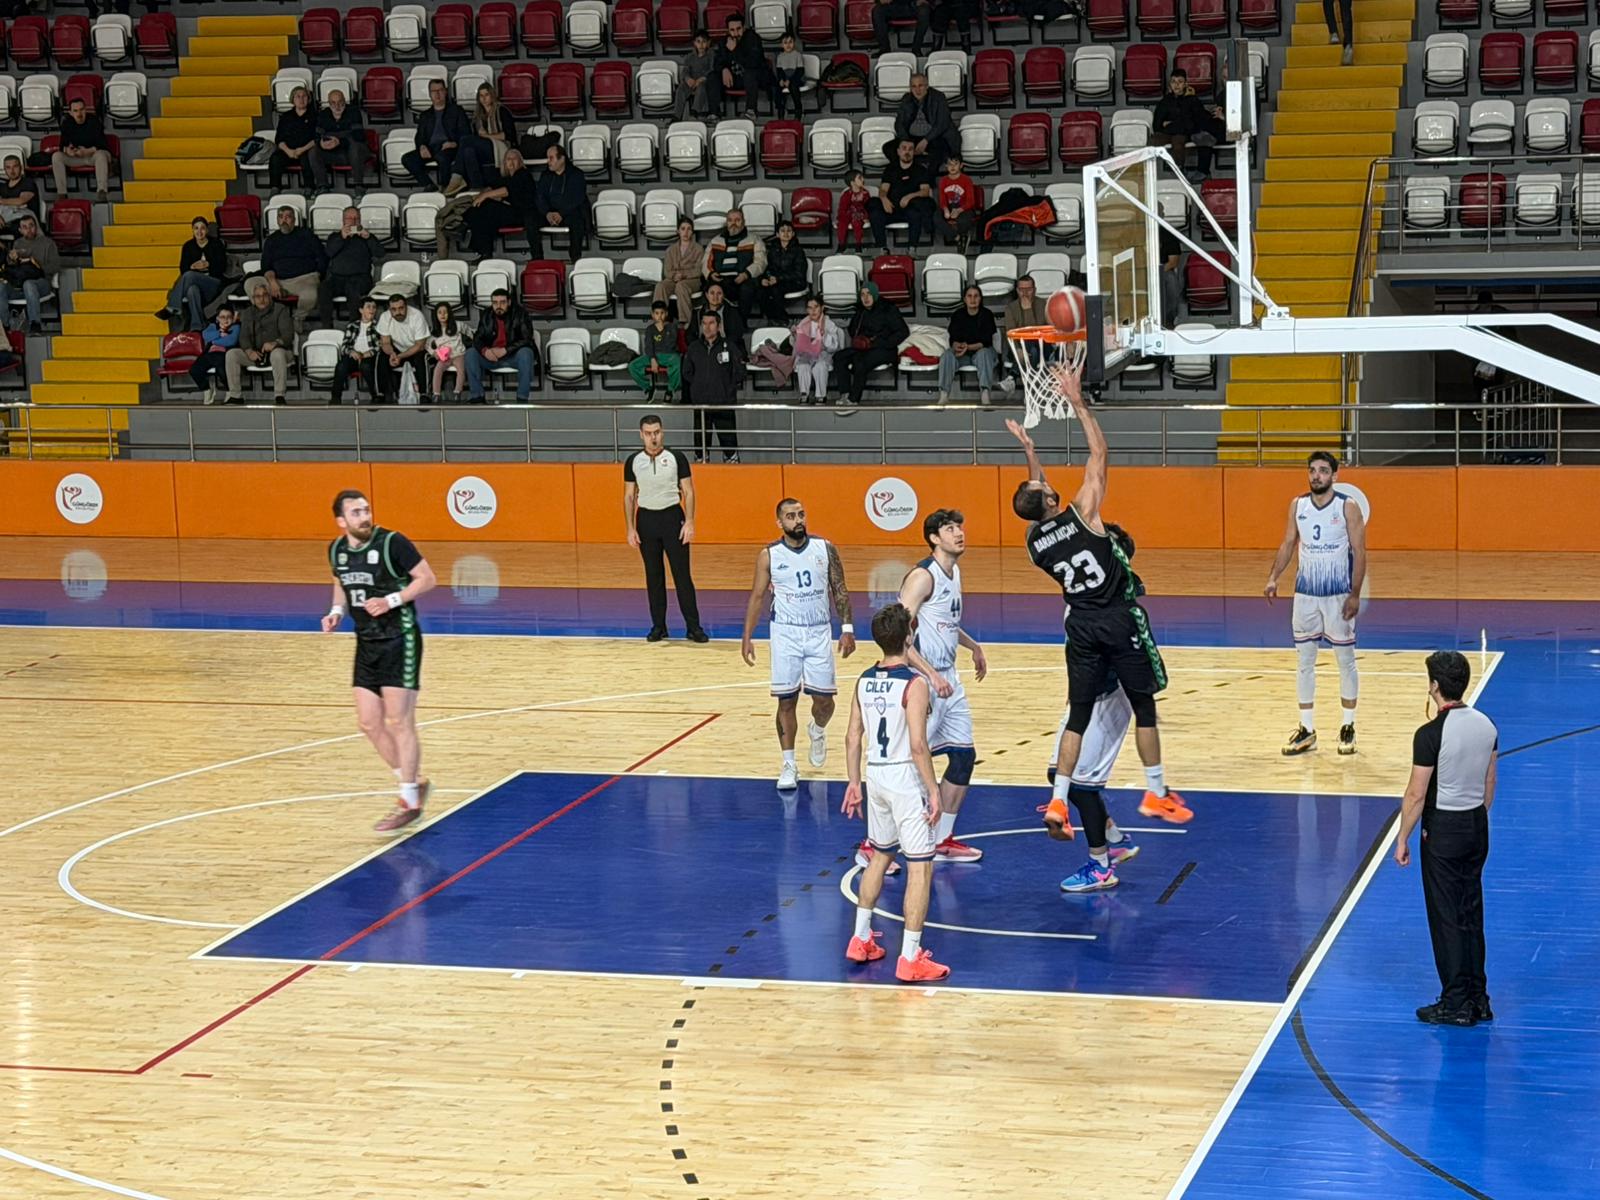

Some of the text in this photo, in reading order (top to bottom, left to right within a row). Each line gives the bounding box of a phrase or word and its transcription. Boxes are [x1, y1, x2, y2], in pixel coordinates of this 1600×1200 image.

[1312, 524, 1321, 541] 3
[796, 570, 812, 588] 13
[1053, 549, 1106, 594] 23
[950, 598, 961, 618] 44
[877, 717, 890, 758] 4
